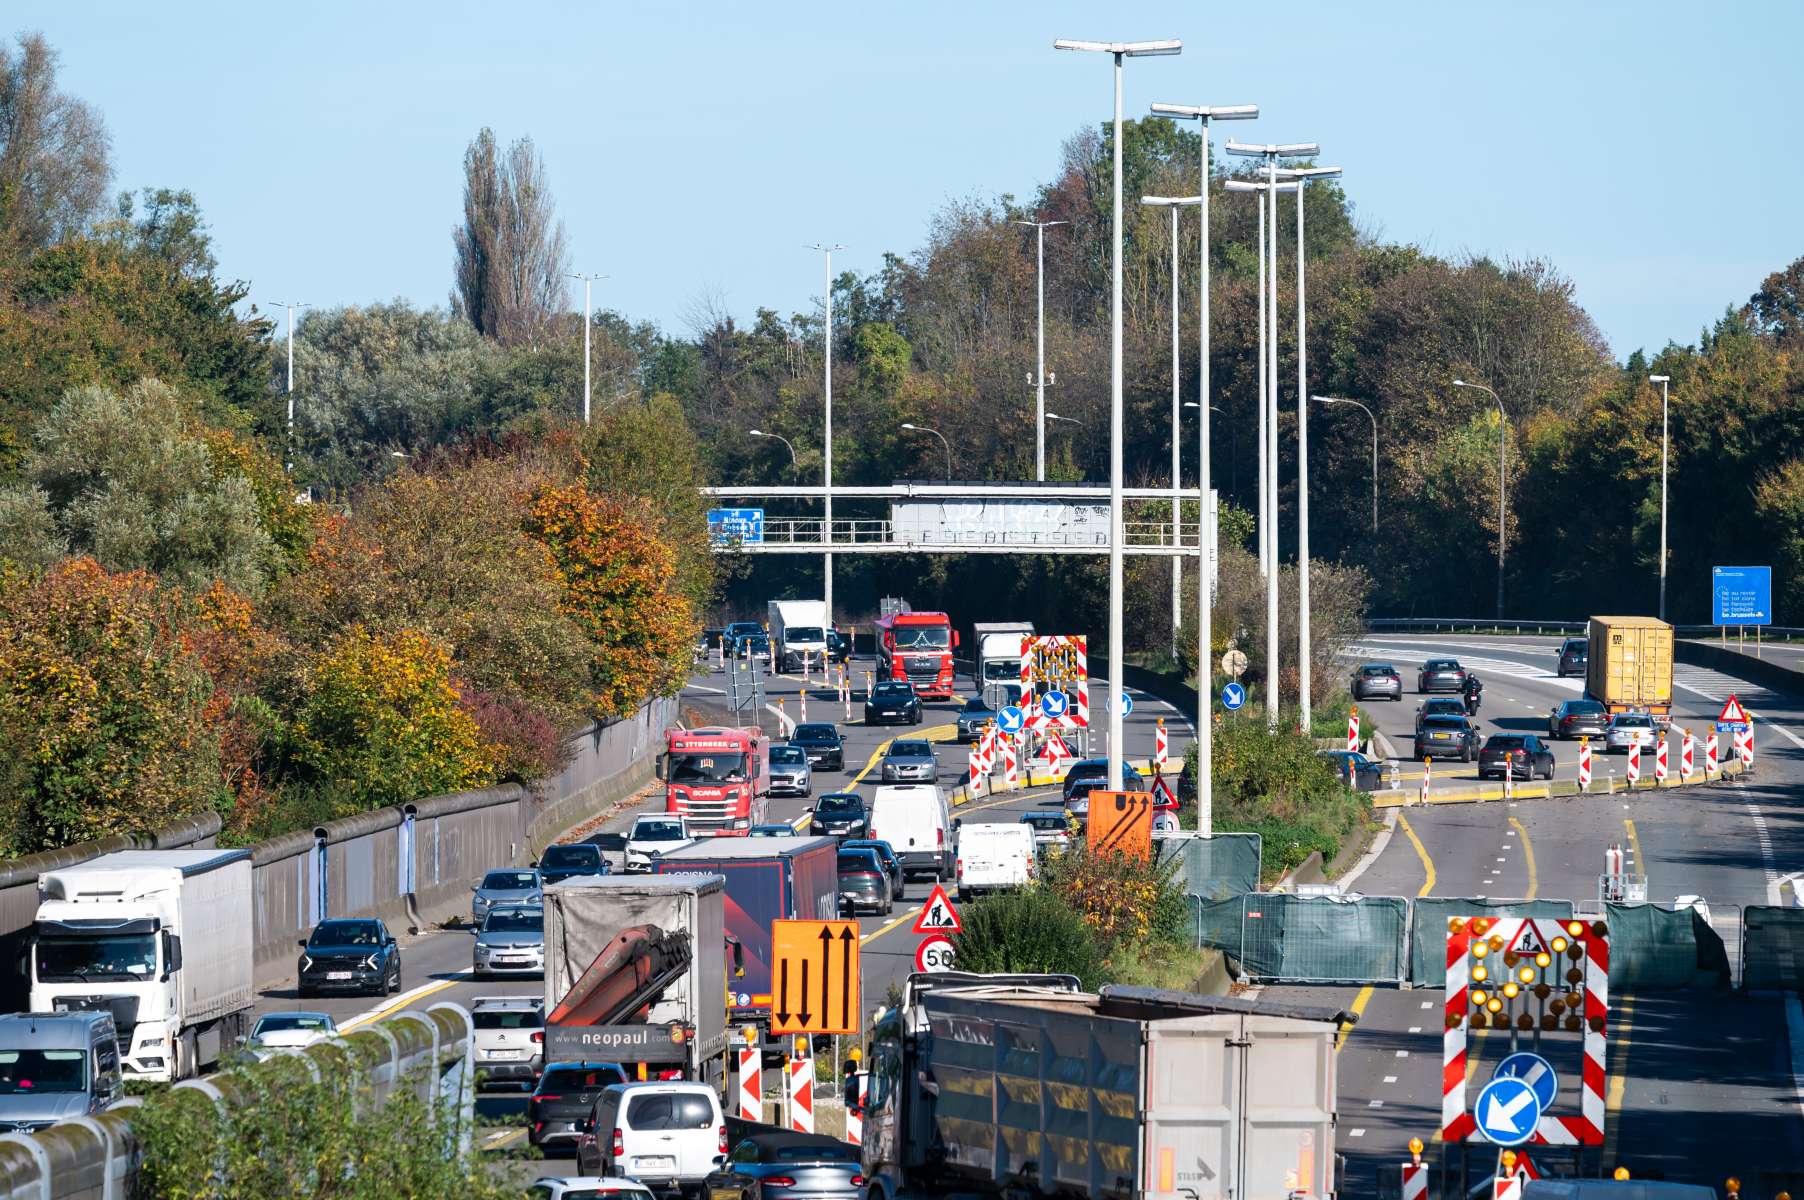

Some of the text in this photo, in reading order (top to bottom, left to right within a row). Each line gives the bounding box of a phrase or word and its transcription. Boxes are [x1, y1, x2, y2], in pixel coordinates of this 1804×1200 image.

[927, 949, 954, 968] 50
[555, 1034, 578, 1043] www
[582, 1030, 647, 1047] neopaul
